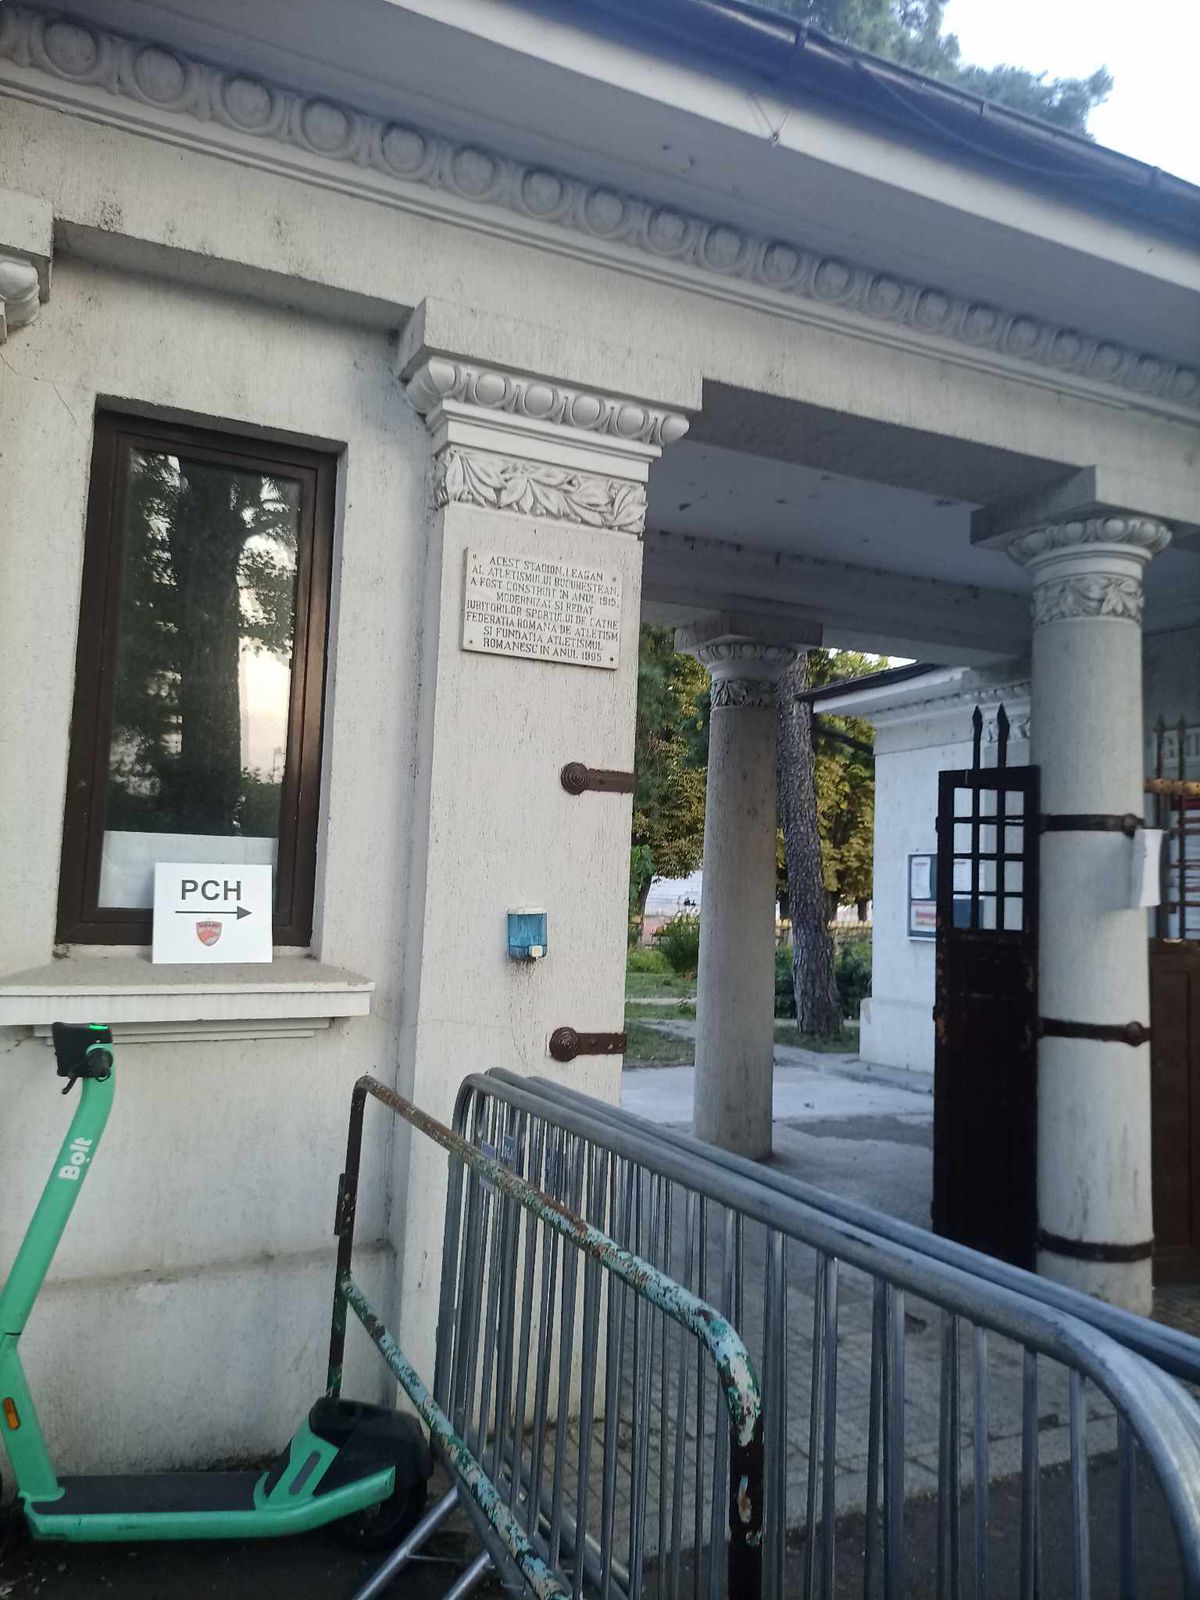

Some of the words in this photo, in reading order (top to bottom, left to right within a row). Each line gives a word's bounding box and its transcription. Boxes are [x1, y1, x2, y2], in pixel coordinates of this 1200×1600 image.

[472, 564, 484, 575] AL
[487, 567, 552, 586] ATLETISMULUI
[489, 556, 520, 569] ACEST
[470, 577, 477, 586] A
[480, 577, 503, 590] FOST
[506, 581, 556, 598] CONSTRUIT
[571, 592, 596, 604] ANUL
[467, 599, 522, 616] IUBITORILOR
[525, 607, 574, 624] SPORTULUI
[575, 615, 586, 626] DE
[496, 592, 552, 609] MODERNIZAT
[554, 600, 564, 611] SI
[566, 602, 594, 616] REDAT
[466, 611, 515, 627] FEDERATIA
[517, 618, 557, 633] ROMANA
[560, 624, 572, 635] DE
[574, 627, 619, 642] ATLETISM
[483, 625, 493, 636] SI
[496, 627, 543, 643] FUNDATIA
[547, 634, 603, 652] ATLETISMUL
[482, 637, 538, 654] ROMANESC
[539, 645, 550, 655] IN
[552, 646, 578, 659] ANUL
[180, 879, 242, 901] PCH
[58, 1136, 92, 1181] Bolt
